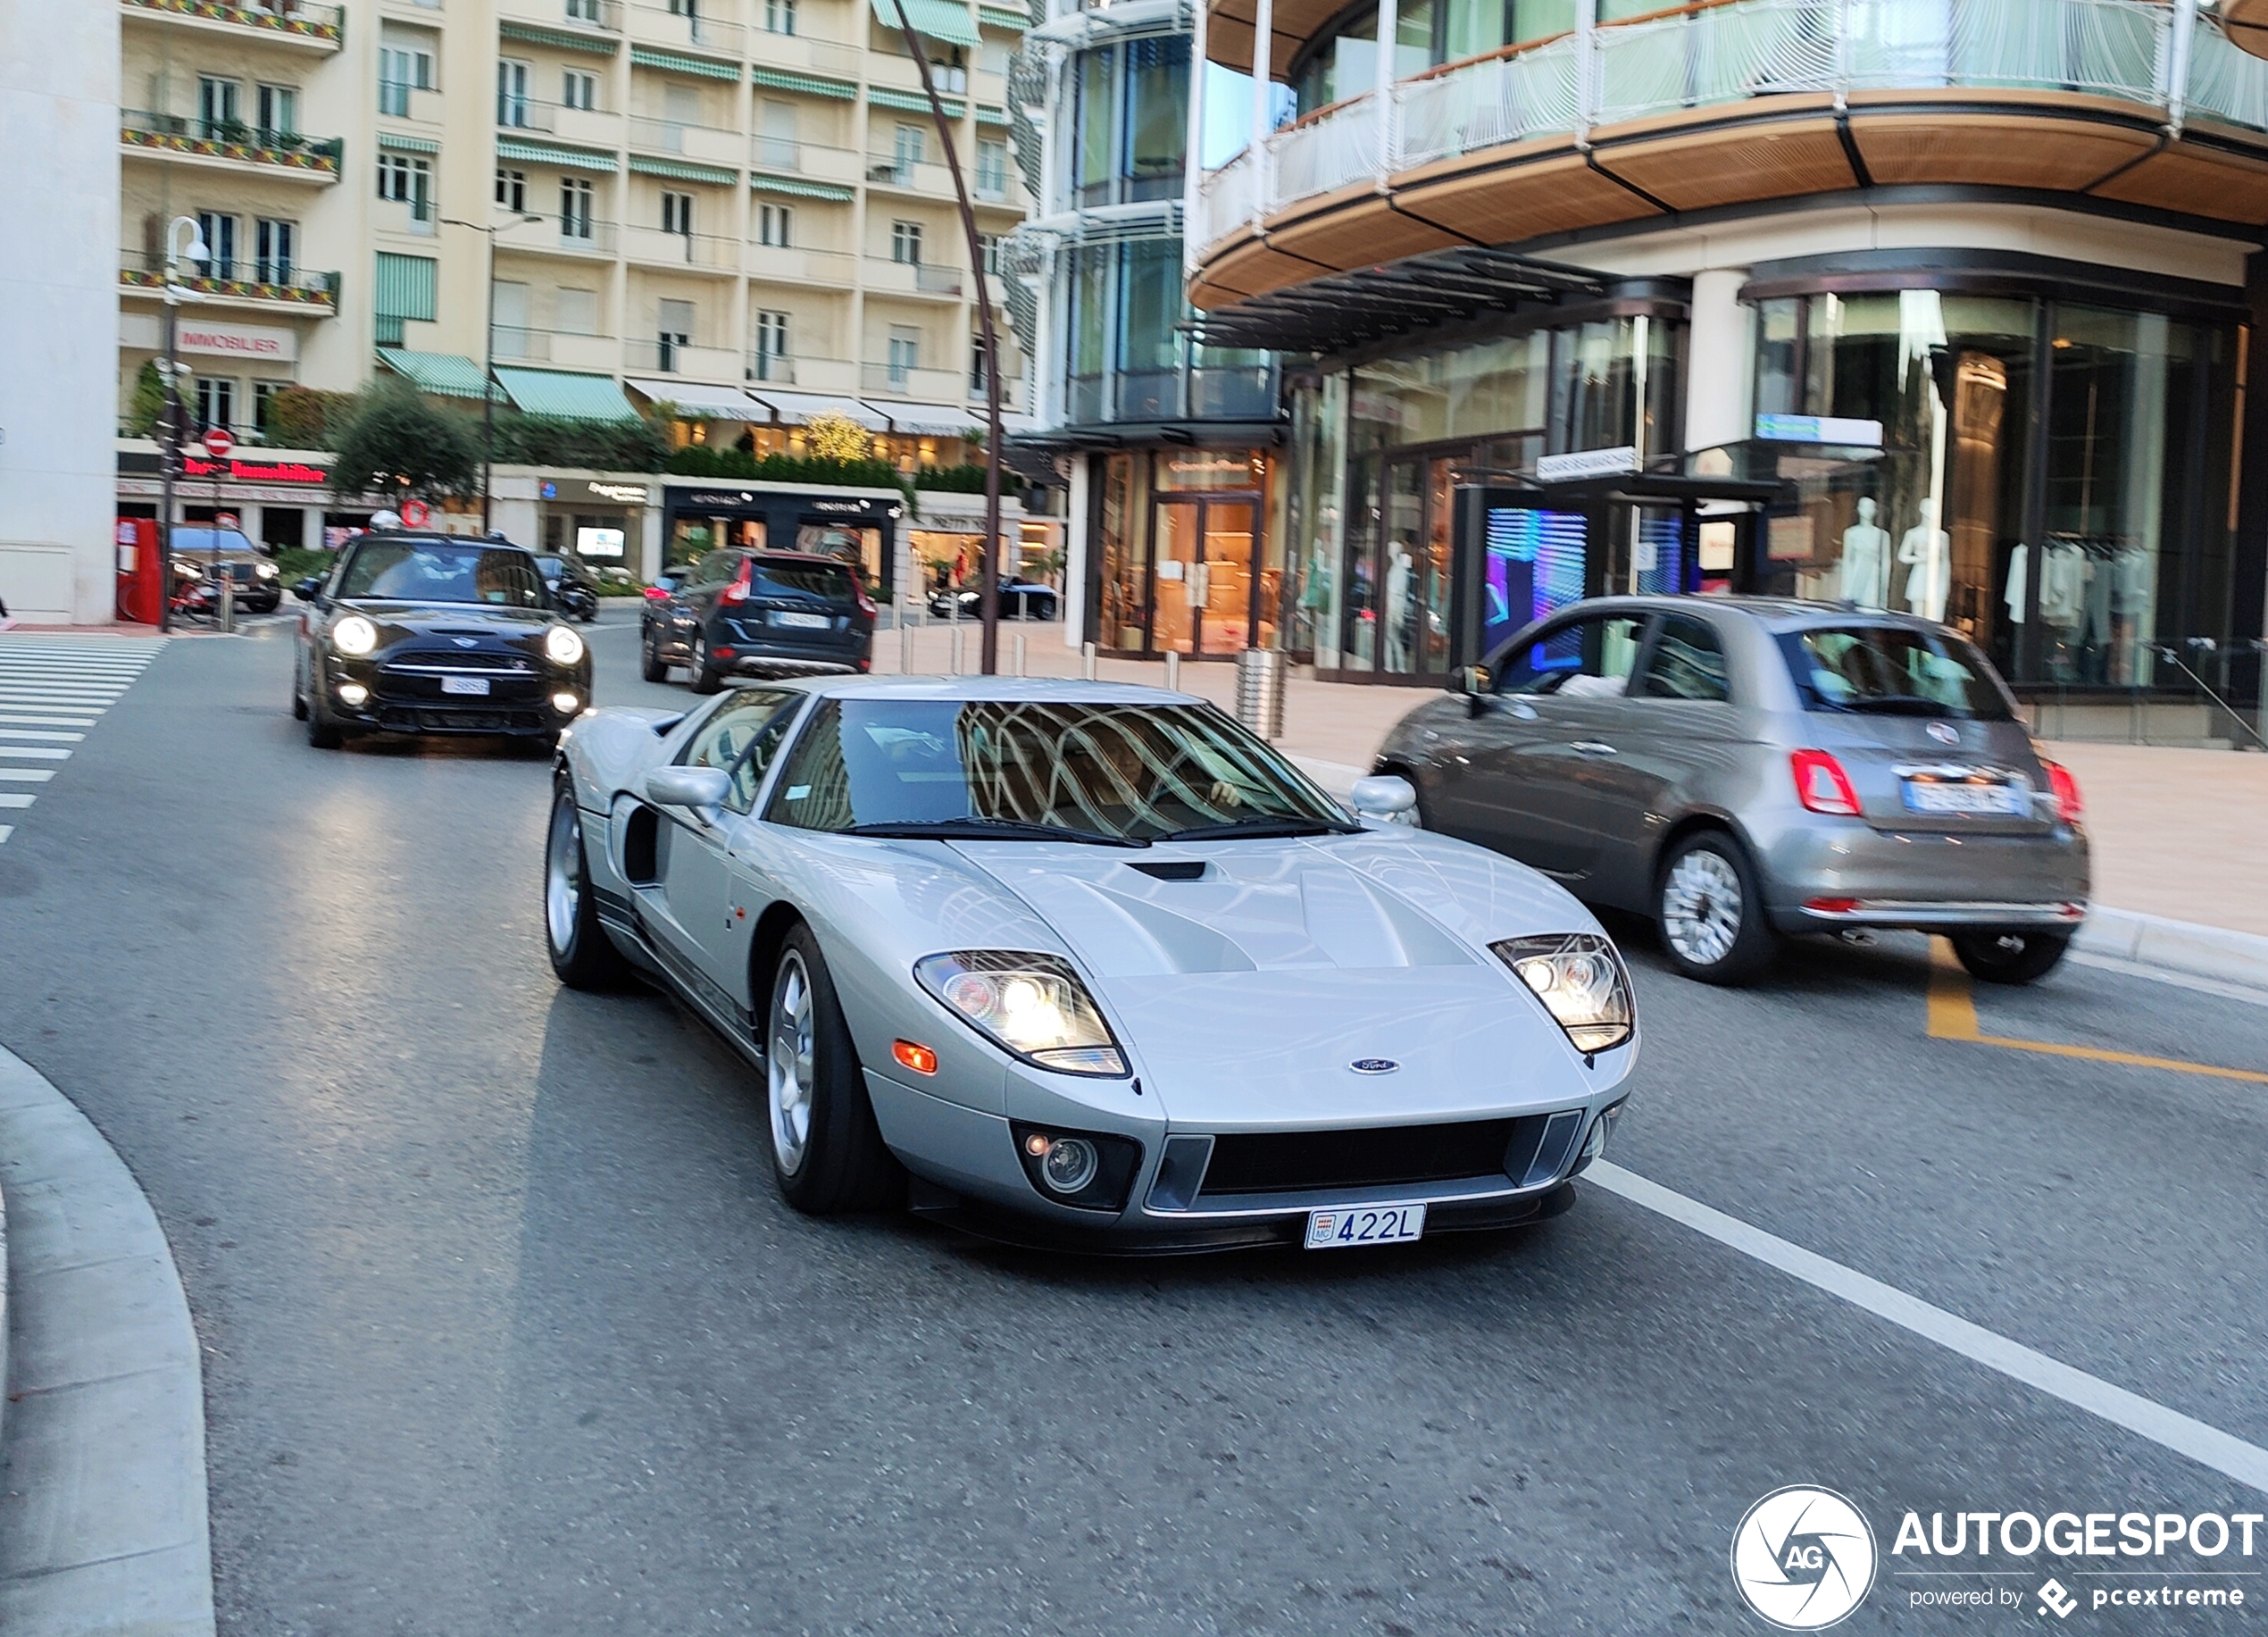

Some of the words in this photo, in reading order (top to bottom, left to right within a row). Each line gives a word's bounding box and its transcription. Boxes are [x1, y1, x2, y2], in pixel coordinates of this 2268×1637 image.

[1361, 1059, 1388, 1069] Ford
[1315, 1229, 1330, 1239] MC
[1338, 1210, 1415, 1241] 422L
